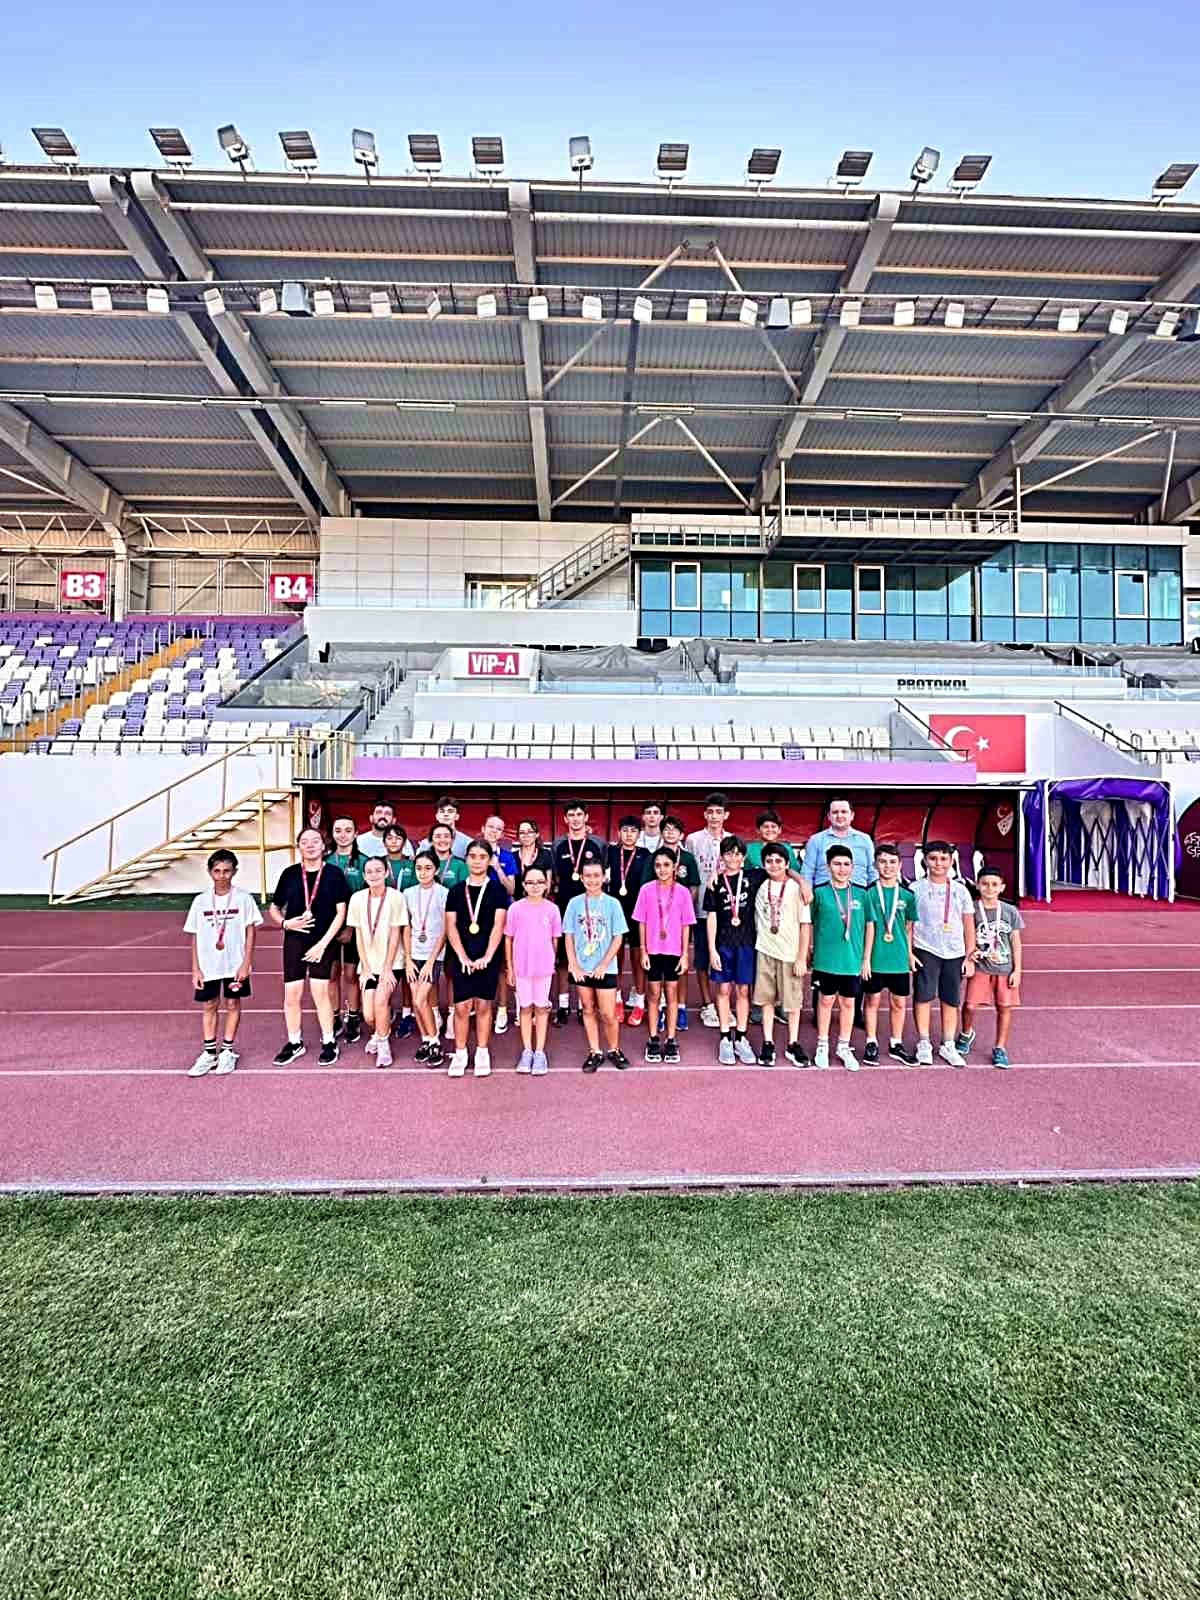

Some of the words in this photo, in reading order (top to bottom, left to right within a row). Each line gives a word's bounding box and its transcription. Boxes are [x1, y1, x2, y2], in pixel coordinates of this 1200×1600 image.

[66, 574, 101, 597] B3
[274, 576, 308, 599] B4
[897, 679, 969, 691] PROTOKOL
